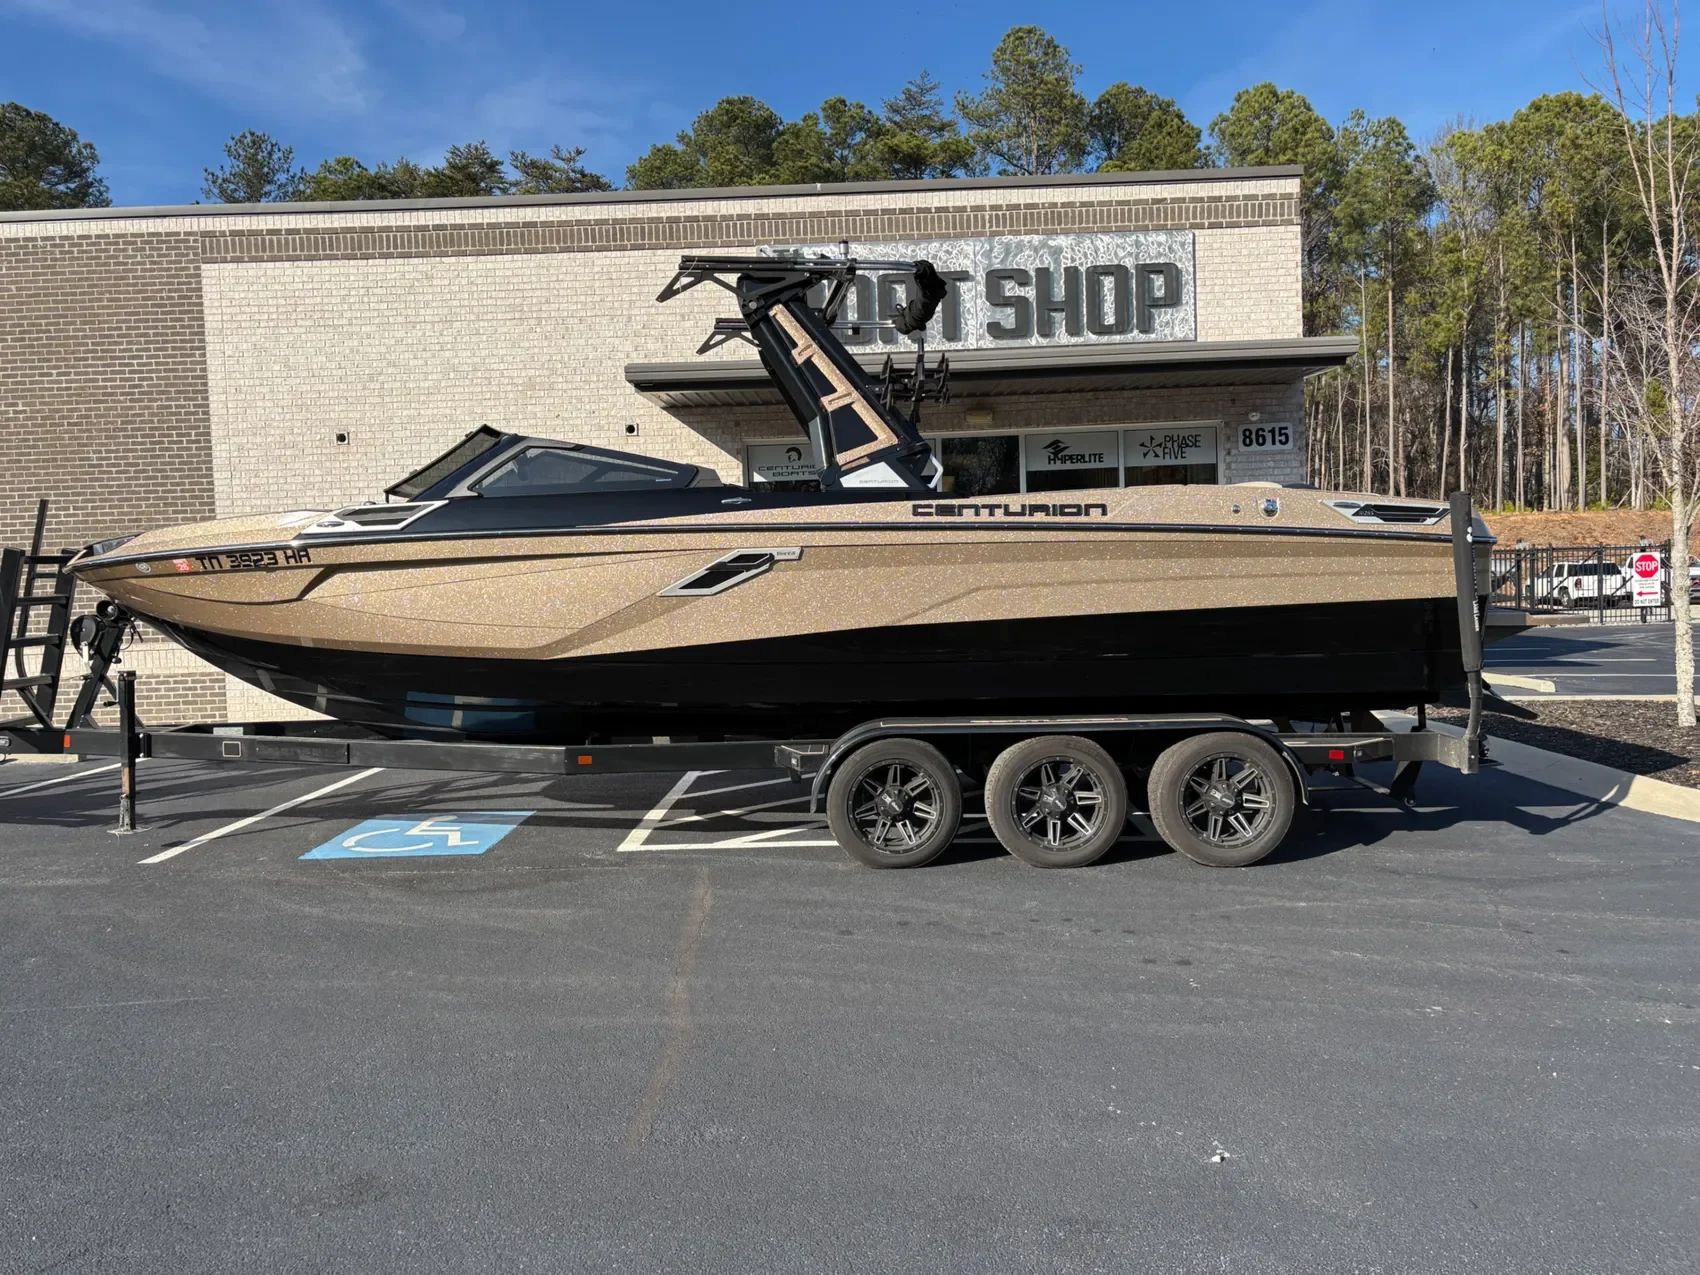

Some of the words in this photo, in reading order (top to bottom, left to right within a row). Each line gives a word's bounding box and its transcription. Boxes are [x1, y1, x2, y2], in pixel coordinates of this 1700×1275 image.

[806, 270, 971, 344] OAT
[986, 262, 1181, 339] SHOP
[1163, 434, 1202, 449] PHASE
[1242, 426, 1290, 447] 8615
[1048, 452, 1104, 465] HYPERLITE
[1162, 446, 1188, 460] FIVE
[911, 503, 1108, 517] CENTURION
[1636, 562, 1657, 572] STOP
